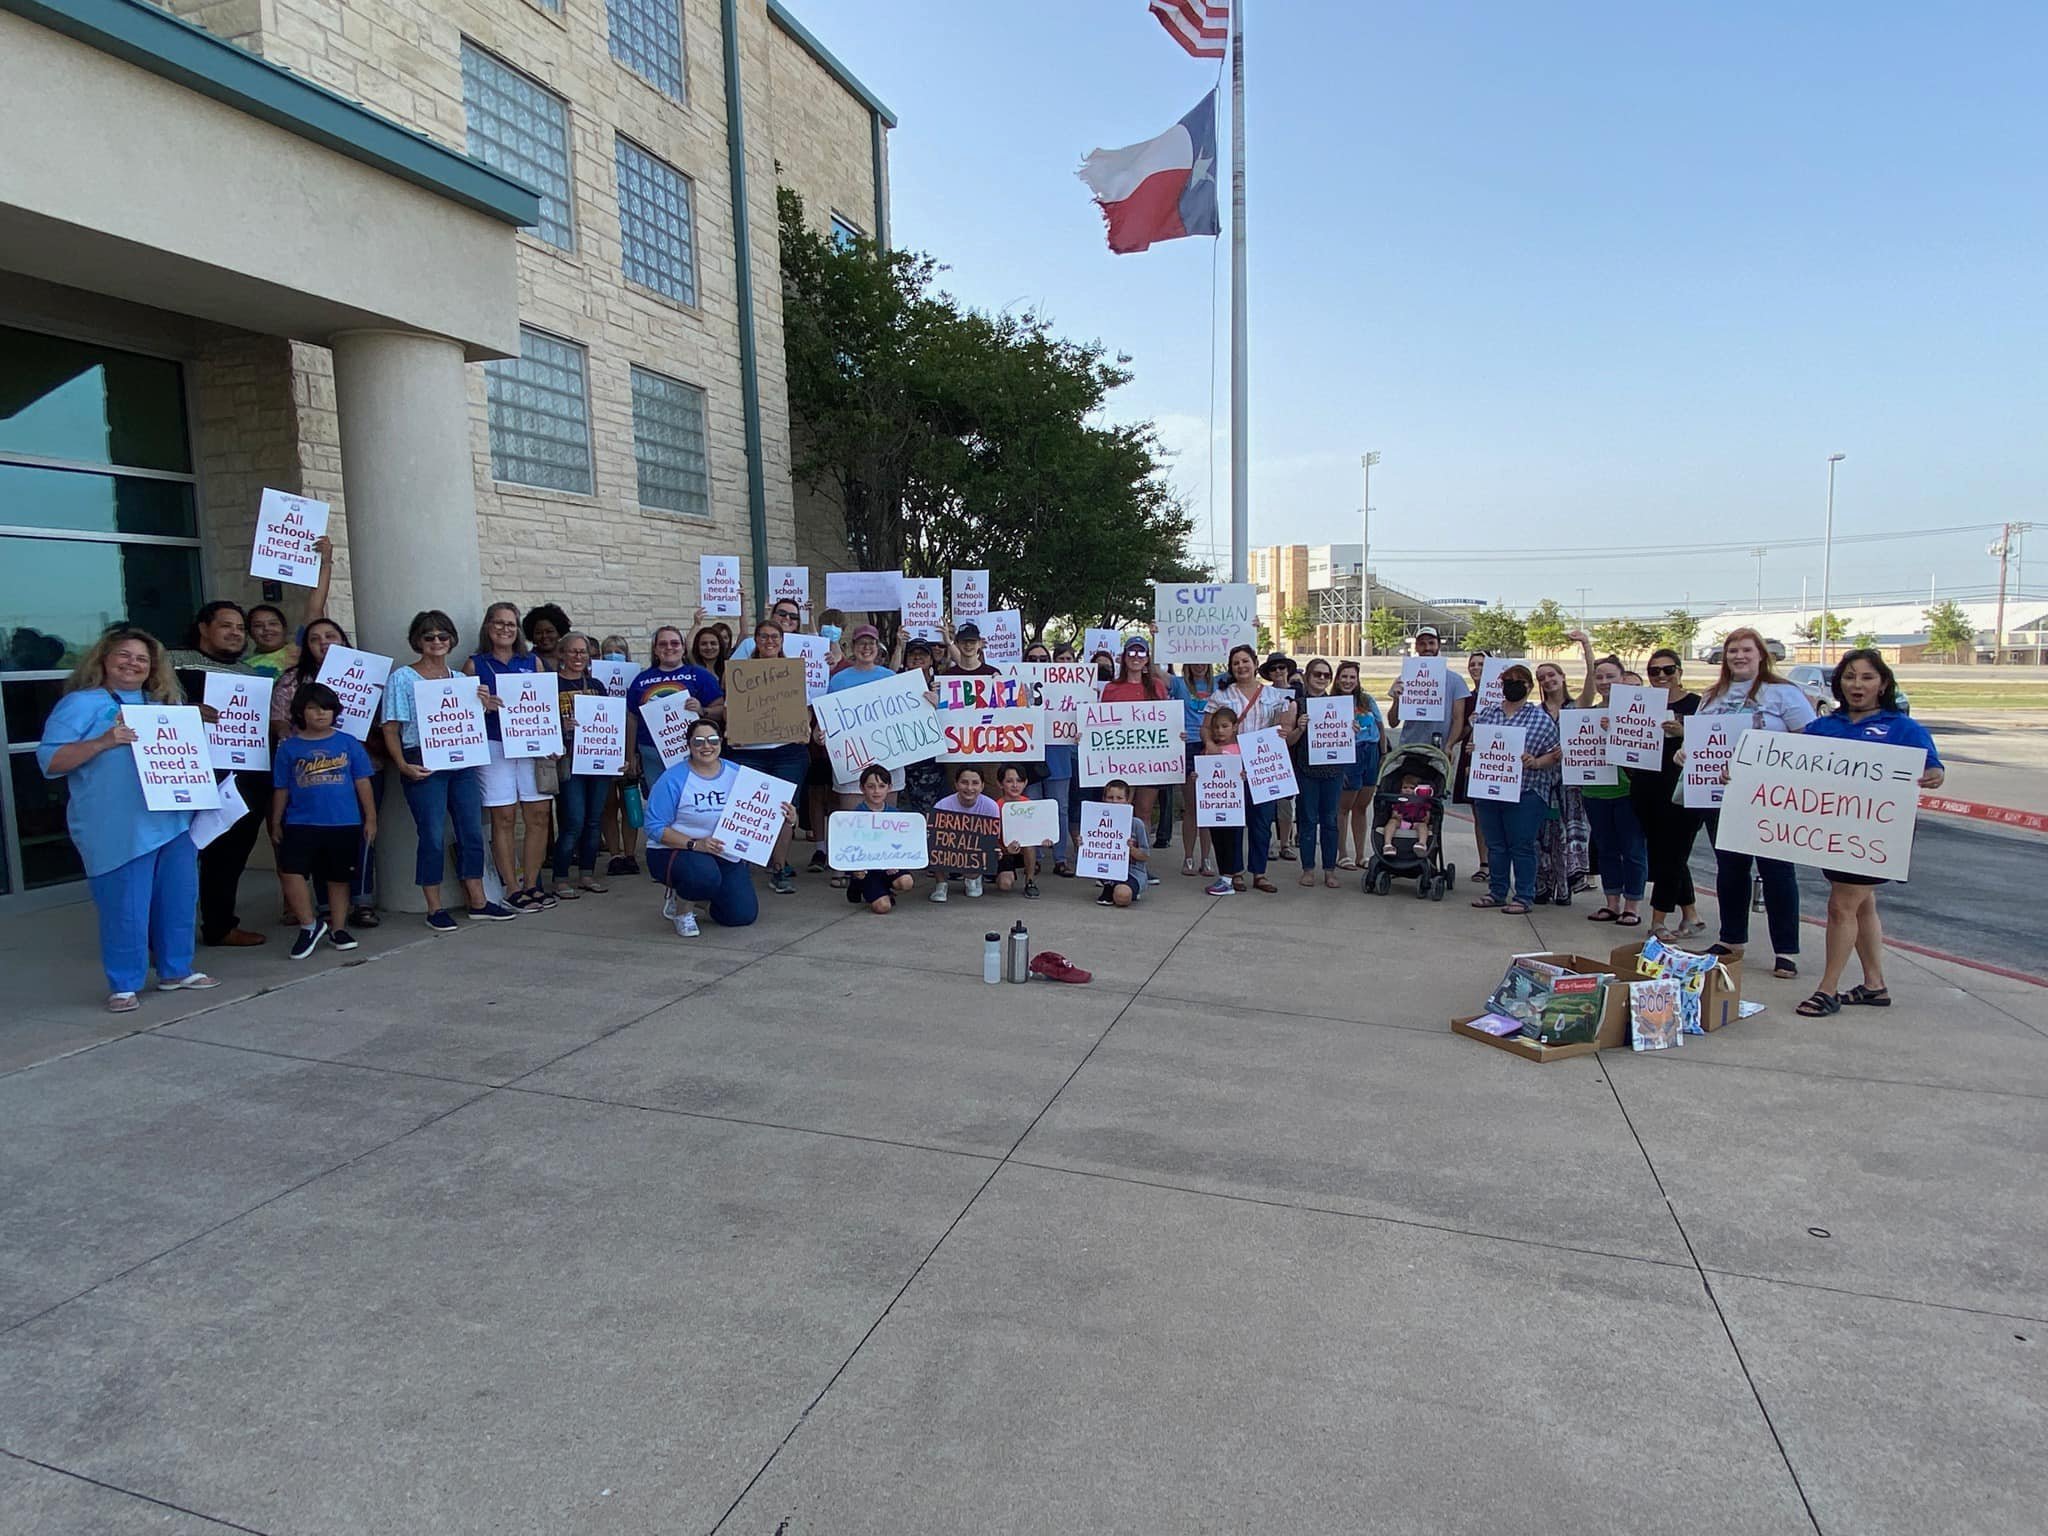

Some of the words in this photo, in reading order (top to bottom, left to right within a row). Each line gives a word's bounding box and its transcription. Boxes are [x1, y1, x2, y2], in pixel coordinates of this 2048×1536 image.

[284, 512, 304, 526] All
[267, 524, 316, 541] schools
[268, 536, 300, 550] need
[303, 544, 312, 553] a
[258, 544, 317, 566] librarian!
[716, 568, 727, 576] All
[703, 594, 738, 602] librarian!
[916, 592, 928, 600] All
[1176, 586, 1222, 604] CUT
[907, 600, 938, 609] schools
[909, 610, 930, 618] need
[1158, 606, 1248, 624] LIBRARIAN
[904, 618, 940, 627] librarian!
[988, 632, 1016, 641] schools
[1168, 624, 1240, 639] FUNDING?
[800, 649, 812, 658] All
[986, 648, 1020, 658] librarian!
[344, 668, 364, 680] All
[1416, 670, 1430, 678] All
[326, 676, 374, 695] schools
[610, 676, 623, 686] All
[640, 676, 662, 687] TAKE
[1406, 679, 1438, 688] schools
[520, 691, 537, 702] All
[936, 679, 1043, 710] LIBRARIANS
[1407, 688, 1430, 696] need
[229, 695, 247, 707] All
[358, 696, 366, 706] a
[441, 697, 458, 709] All
[1402, 696, 1442, 706] librarian!
[344, 704, 371, 720] rian!
[507, 702, 551, 714] schools
[1629, 703, 1645, 714] All
[427, 709, 475, 723] schools
[511, 714, 538, 726] need
[594, 712, 608, 723] All
[665, 710, 679, 724] All
[818, 691, 920, 738] Librarians
[1086, 705, 1122, 726] ALL
[1324, 710, 1337, 719] All
[1314, 720, 1348, 729] schools
[1616, 715, 1656, 728] schools
[215, 722, 246, 734] need
[250, 726, 257, 734] a
[431, 722, 463, 736] need
[466, 724, 474, 732] a
[505, 725, 557, 738] librarian!
[582, 723, 618, 734] schools
[1052, 721, 1078, 738] BOO
[1579, 725, 1594, 734] All
[1617, 727, 1644, 738] need
[156, 728, 178, 741] All
[425, 732, 483, 749] librarian!
[583, 736, 608, 745] need
[945, 723, 1034, 754] SUCCESS!
[1092, 728, 1168, 746] DESERVE
[1316, 730, 1340, 739] need
[1707, 734, 1726, 746] All
[209, 734, 265, 748] librarian!
[833, 750, 842, 759] in
[845, 736, 875, 772] ALL
[871, 712, 944, 761] SCHOOLS!
[1312, 738, 1352, 749] librarian!
[1491, 741, 1505, 750] All
[1568, 736, 1606, 746] schools
[1610, 735, 1659, 751] librarian!
[144, 743, 198, 755] schools
[577, 746, 622, 757] librarian!
[1257, 744, 1269, 754] All
[1570, 746, 1596, 756] need
[1692, 748, 1736, 759] school
[1250, 753, 1283, 766] schools
[1479, 751, 1515, 762] schools
[1564, 757, 1613, 766] libraria
[150, 758, 185, 770] need
[190, 761, 198, 770] a
[1254, 765, 1276, 775] need
[1480, 762, 1504, 772] need
[1696, 760, 1728, 772] need
[144, 771, 211, 784] librarian!
[1212, 770, 1225, 779] All
[1251, 770, 1291, 786] librarian!
[1472, 771, 1518, 784] librarian!
[1202, 780, 1237, 789] schools
[694, 791, 726, 806] PfE
[752, 791, 770, 804] All
[1204, 790, 1227, 799] need
[735, 800, 776, 820] schools
[1200, 800, 1241, 809] librarian!
[732, 812, 762, 827] need
[763, 822, 770, 830] a
[872, 814, 910, 833] Love
[926, 812, 1000, 836] LIBRARIANS
[1098, 818, 1112, 828] All
[721, 817, 773, 844] librarian!
[1087, 829, 1123, 840] schools
[936, 831, 956, 848] FOR
[958, 834, 982, 851] ALL
[1089, 840, 1112, 850] need
[1757, 819, 1887, 864] SUCCESS
[1082, 850, 1126, 861] librarian!
